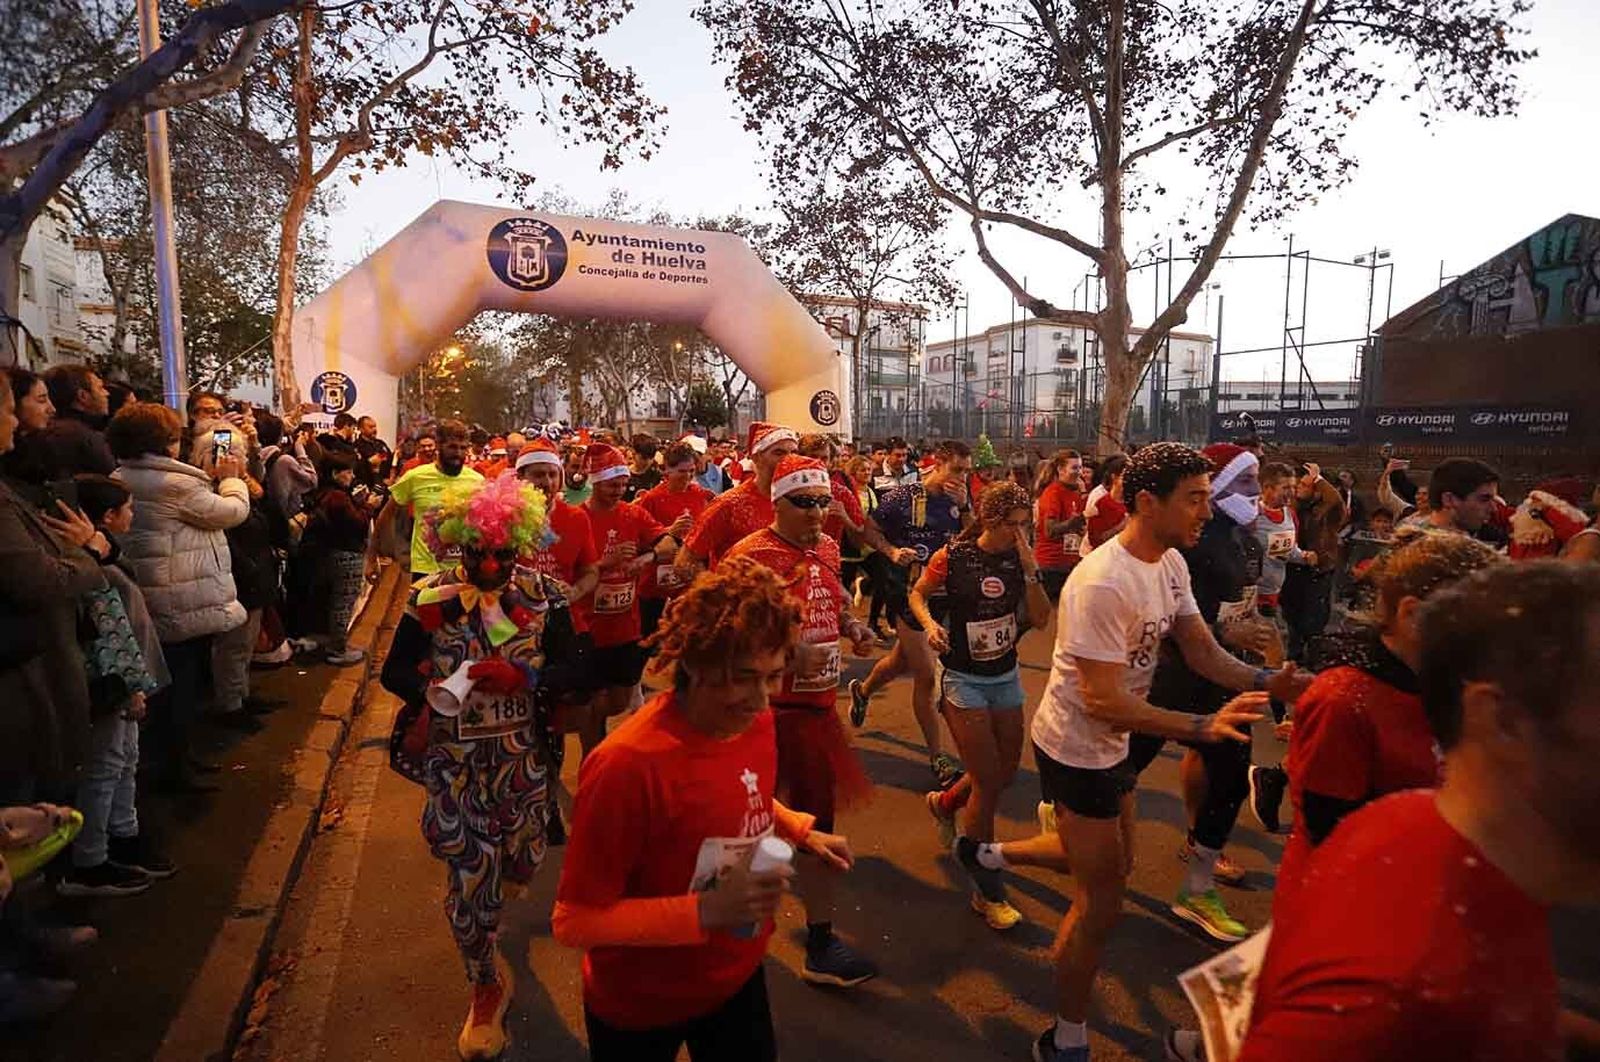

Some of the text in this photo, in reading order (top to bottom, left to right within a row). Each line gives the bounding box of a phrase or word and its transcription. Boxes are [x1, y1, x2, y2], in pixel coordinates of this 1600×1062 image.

[572, 230, 706, 254] Ayuntamiento
[612, 249, 706, 270] de Huelva
[642, 270, 656, 280] de
[659, 271, 708, 284] Deportes
[1236, 419, 1276, 428] HYNDAI
[1304, 417, 1350, 426] HYUNDAI
[1399, 415, 1455, 425] HYUNDAI
[1499, 411, 1568, 423] HYUNDAI
[614, 592, 632, 605] 123
[995, 629, 1011, 646] 84
[491, 697, 527, 720] 188
